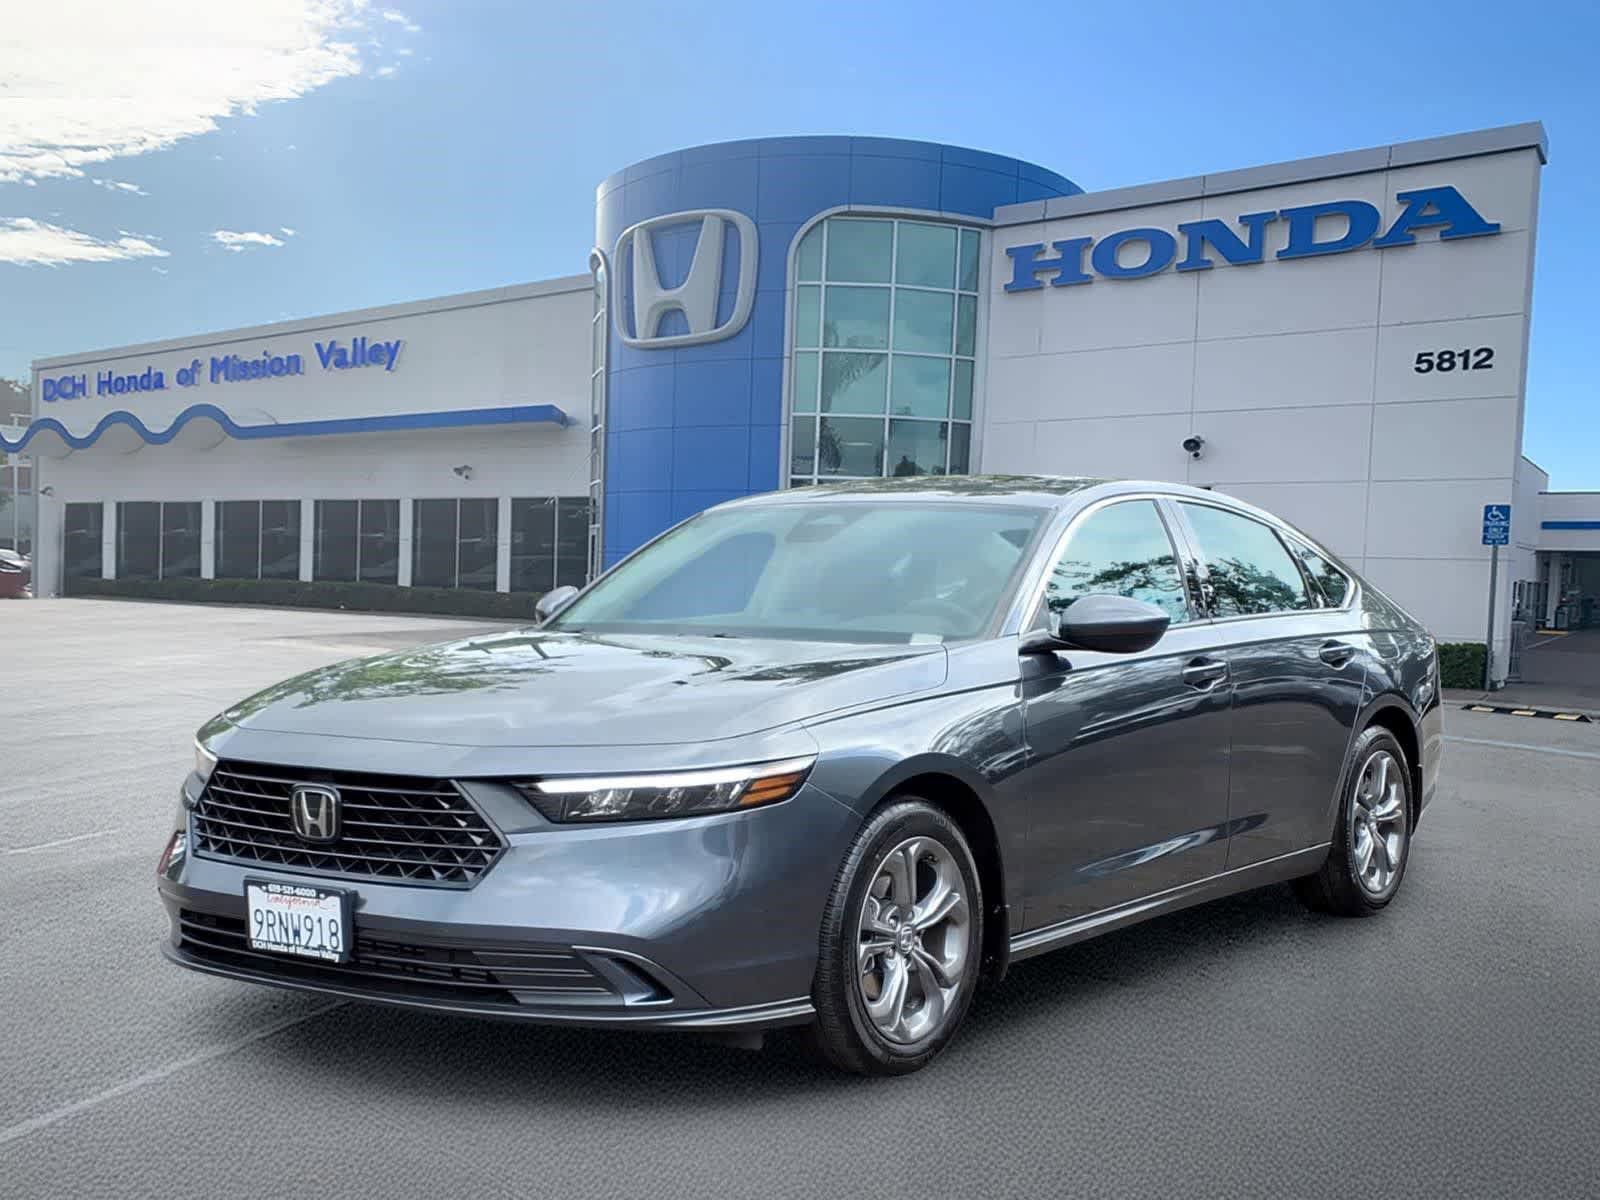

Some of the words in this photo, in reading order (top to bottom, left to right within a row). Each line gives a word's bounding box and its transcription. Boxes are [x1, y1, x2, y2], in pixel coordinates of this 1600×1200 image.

[1004, 185, 1501, 293] HONDA
[42, 374, 87, 402] DCH
[97, 366, 165, 396] Honda
[176, 358, 201, 387] of
[210, 350, 304, 384] Mission
[314, 336, 401, 371] Valley
[1414, 347, 1494, 374] 5812
[253, 908, 340, 950] 9RNW918
